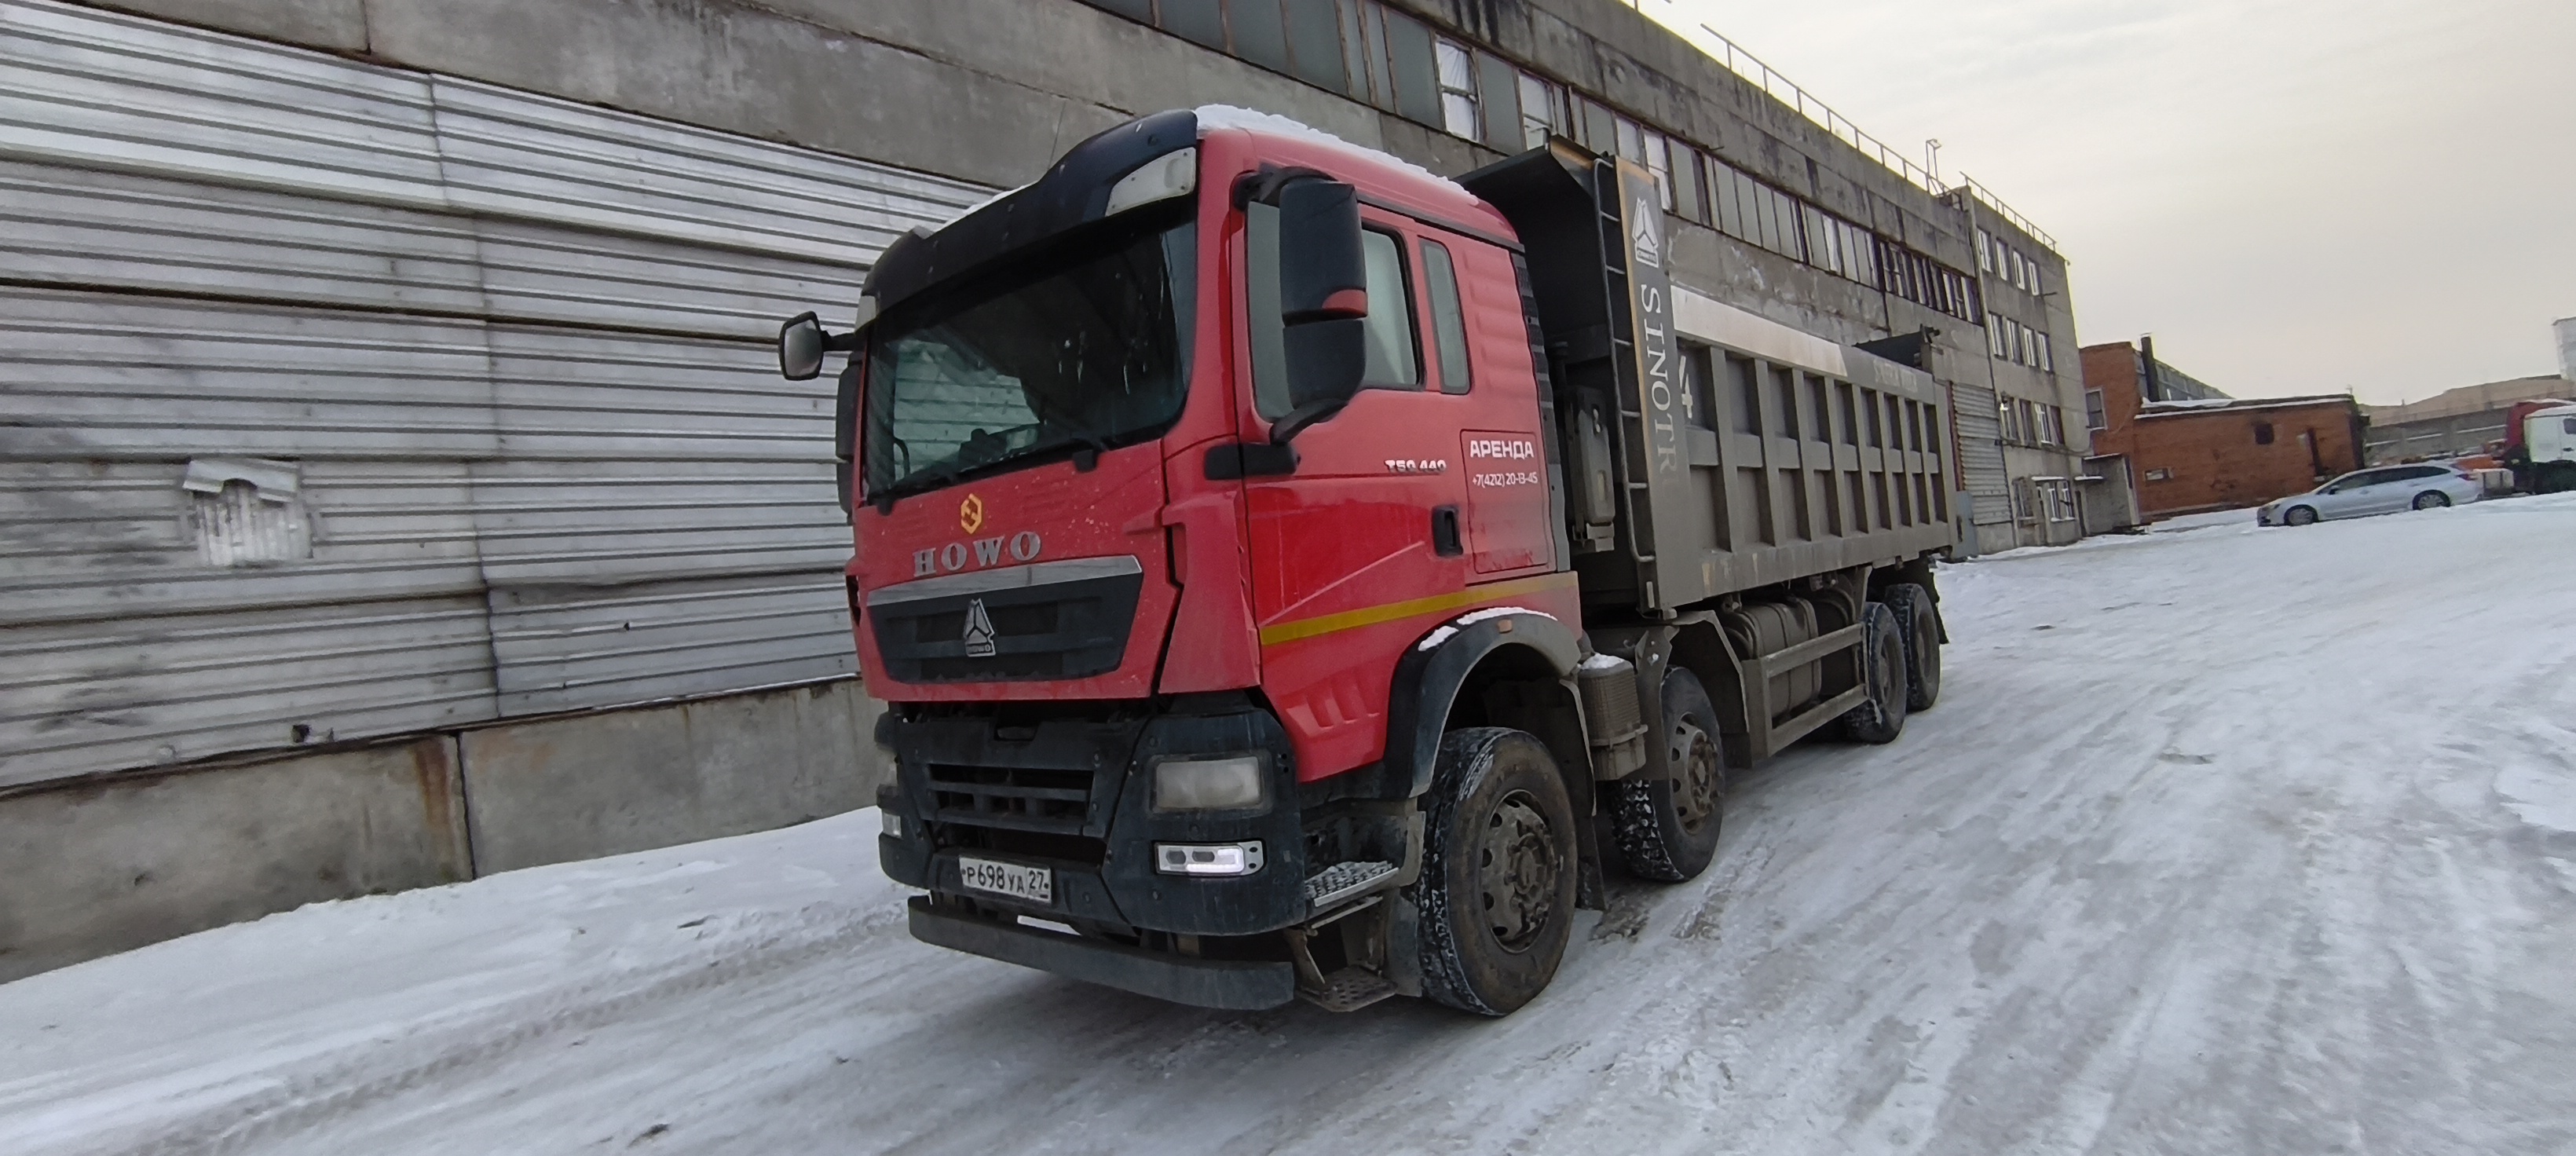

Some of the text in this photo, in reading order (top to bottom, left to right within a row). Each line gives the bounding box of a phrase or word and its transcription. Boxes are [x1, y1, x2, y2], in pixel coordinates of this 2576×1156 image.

[1678, 355, 1693, 419] 4
[1470, 440, 1535, 460] АРЕНДА
[1419, 459, 1447, 472] 440
[1473, 472, 1539, 488] +7(4212) 20-13-45
[913, 531, 1041, 577] HOWO
[1029, 870, 1044, 890] 27
